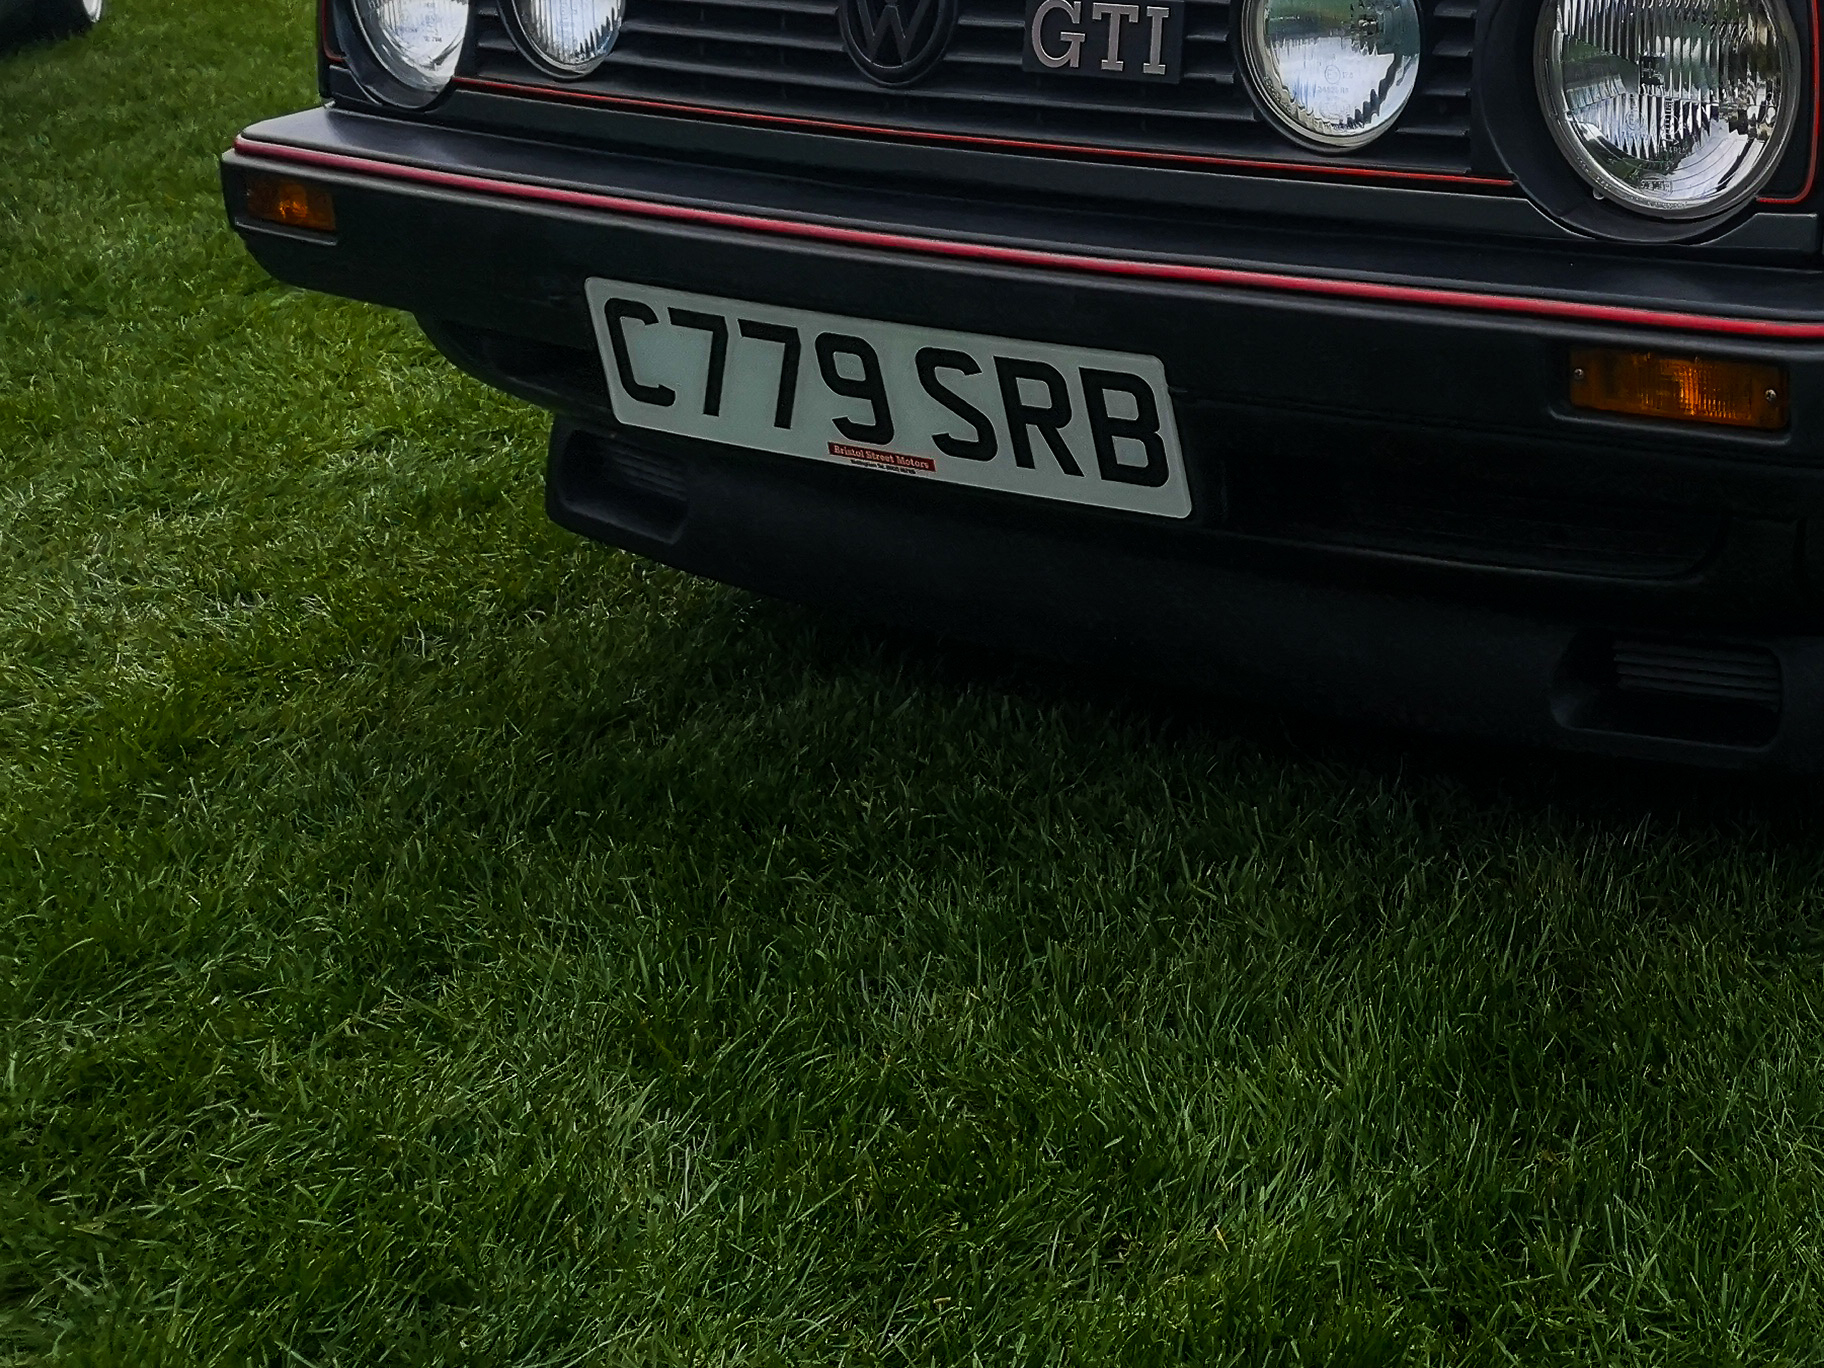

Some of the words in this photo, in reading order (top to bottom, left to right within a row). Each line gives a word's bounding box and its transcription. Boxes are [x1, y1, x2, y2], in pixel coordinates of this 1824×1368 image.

[603, 297, 895, 445] C779
[914, 346, 1170, 488] SRB
[833, 444, 865, 459] Bristol
[865, 450, 895, 464] Street
[895, 455, 930, 470] Motors
